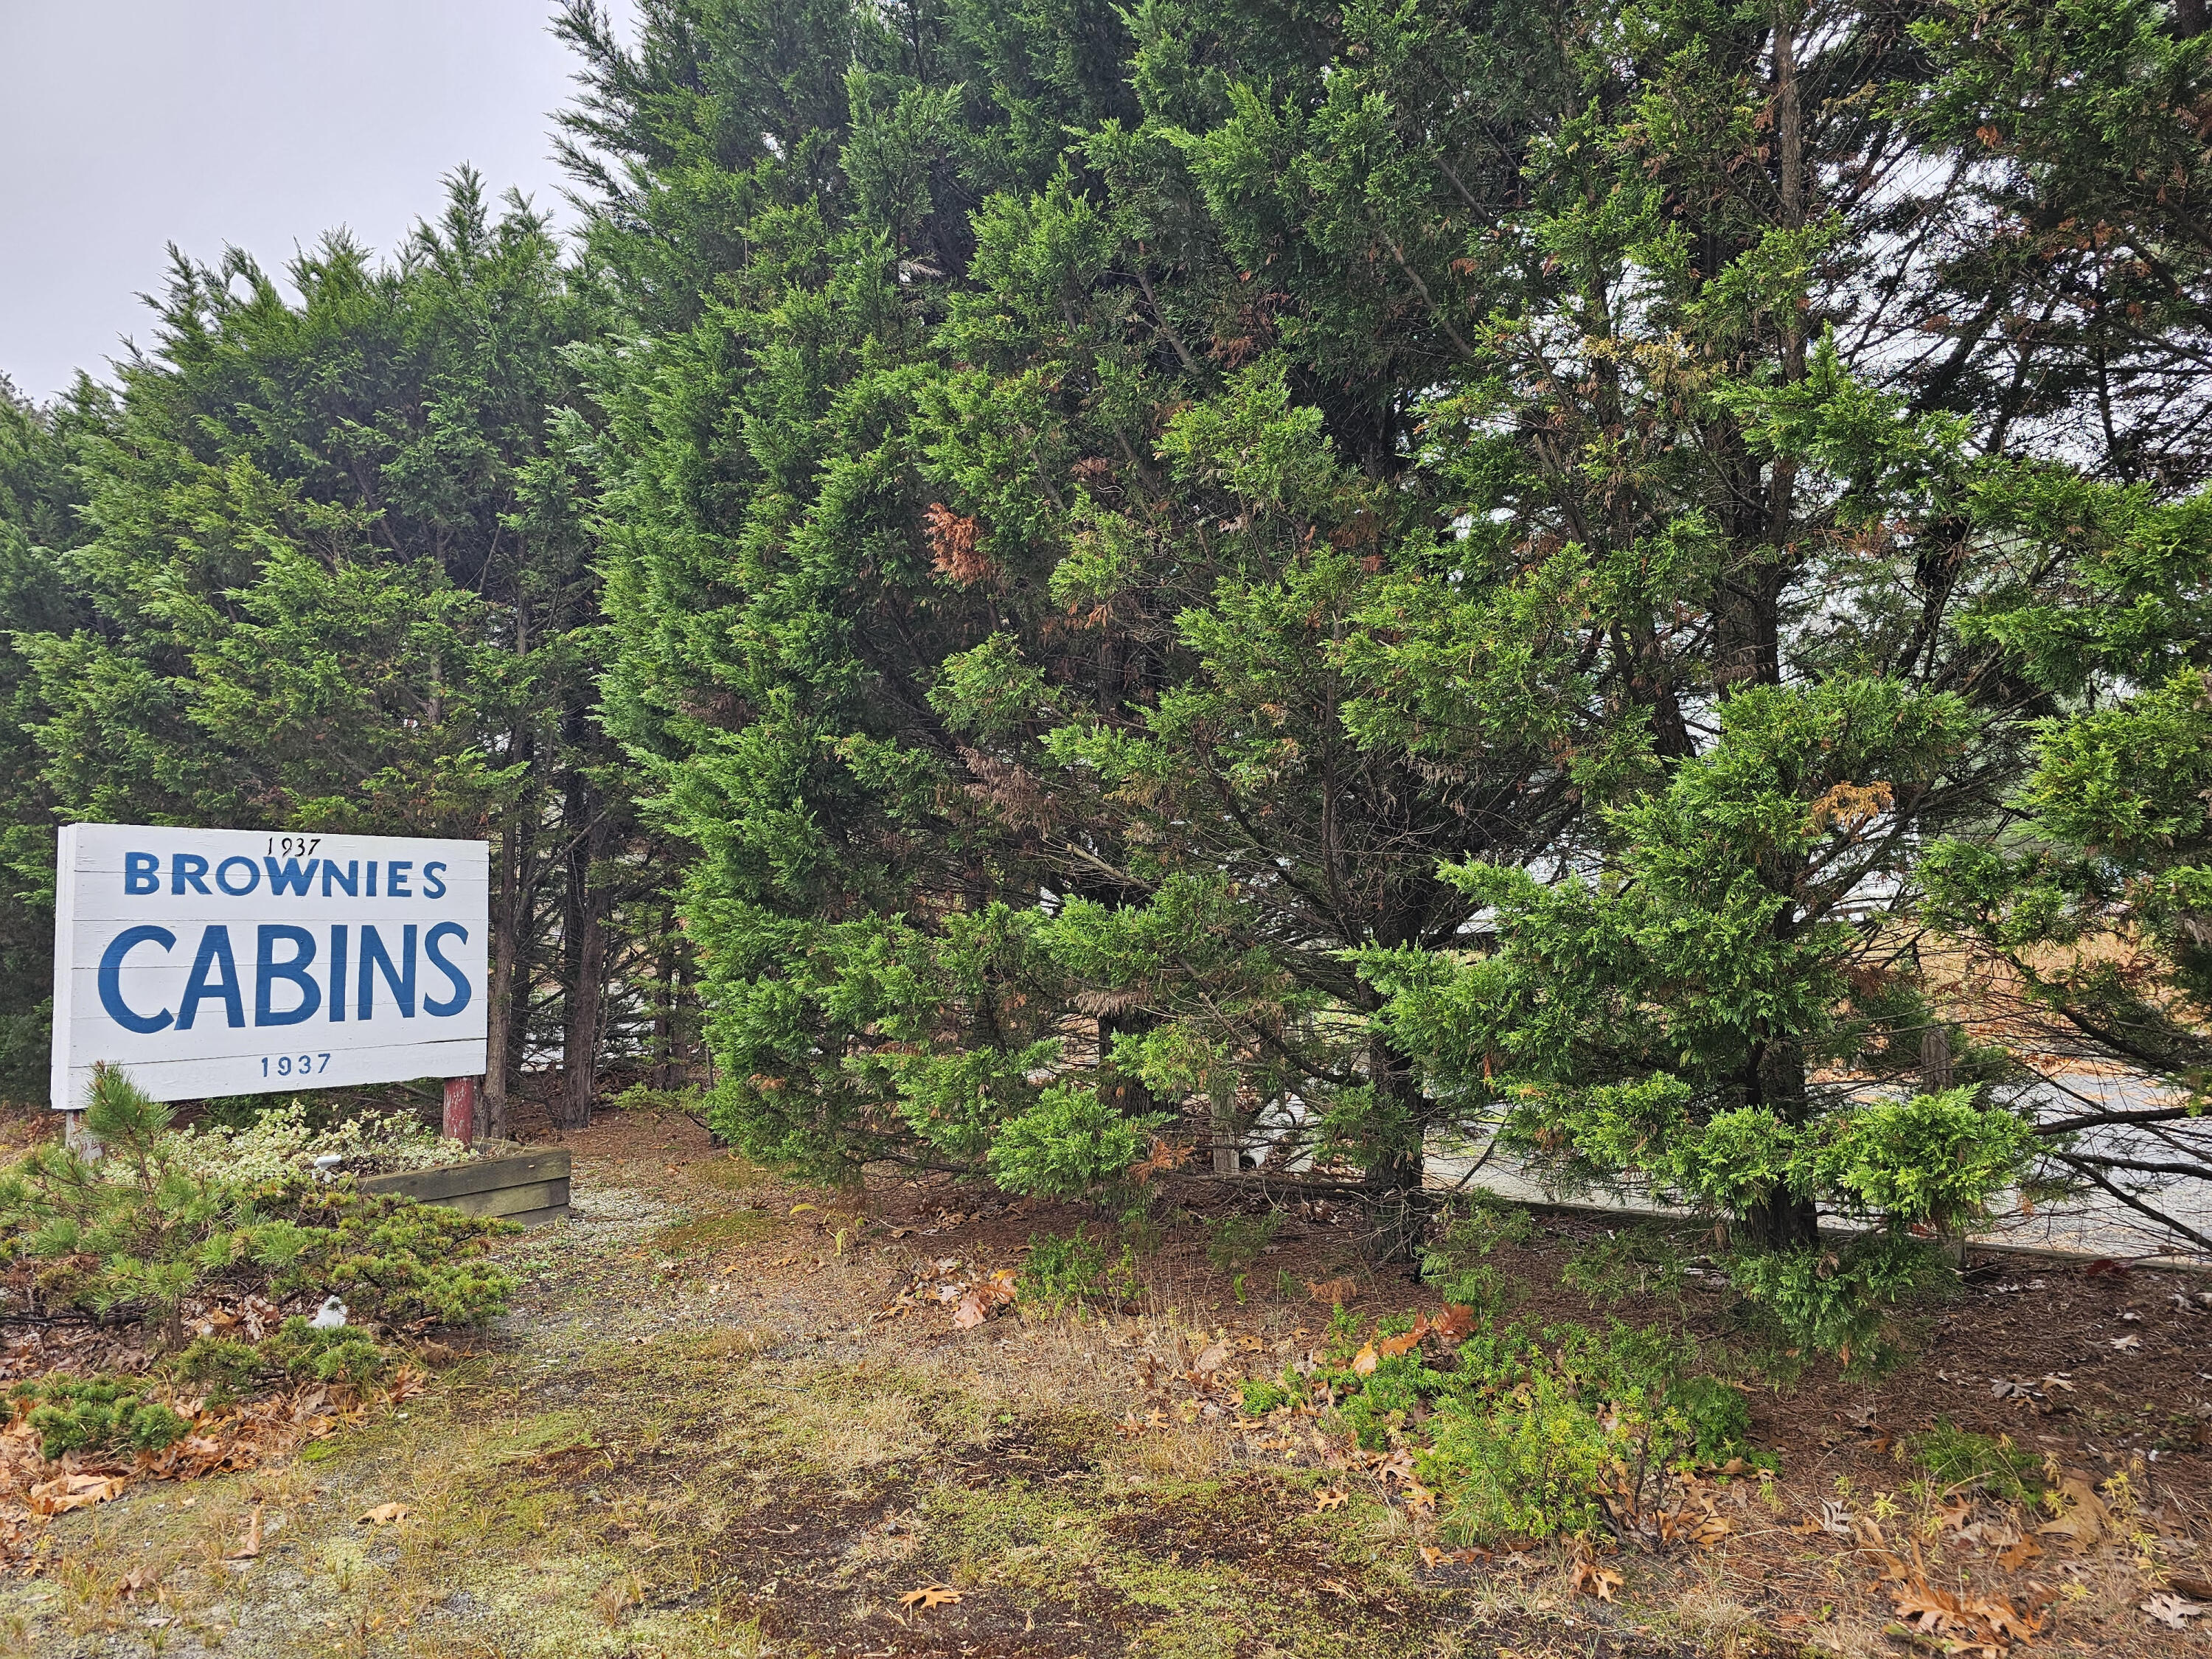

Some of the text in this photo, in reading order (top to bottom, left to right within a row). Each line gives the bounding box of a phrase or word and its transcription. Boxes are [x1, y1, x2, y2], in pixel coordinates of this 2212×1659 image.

[267, 837, 321, 858] 1937
[124, 852, 447, 900] BROWNIES
[97, 921, 473, 1034] CABINS
[261, 1053, 331, 1077] 1937
